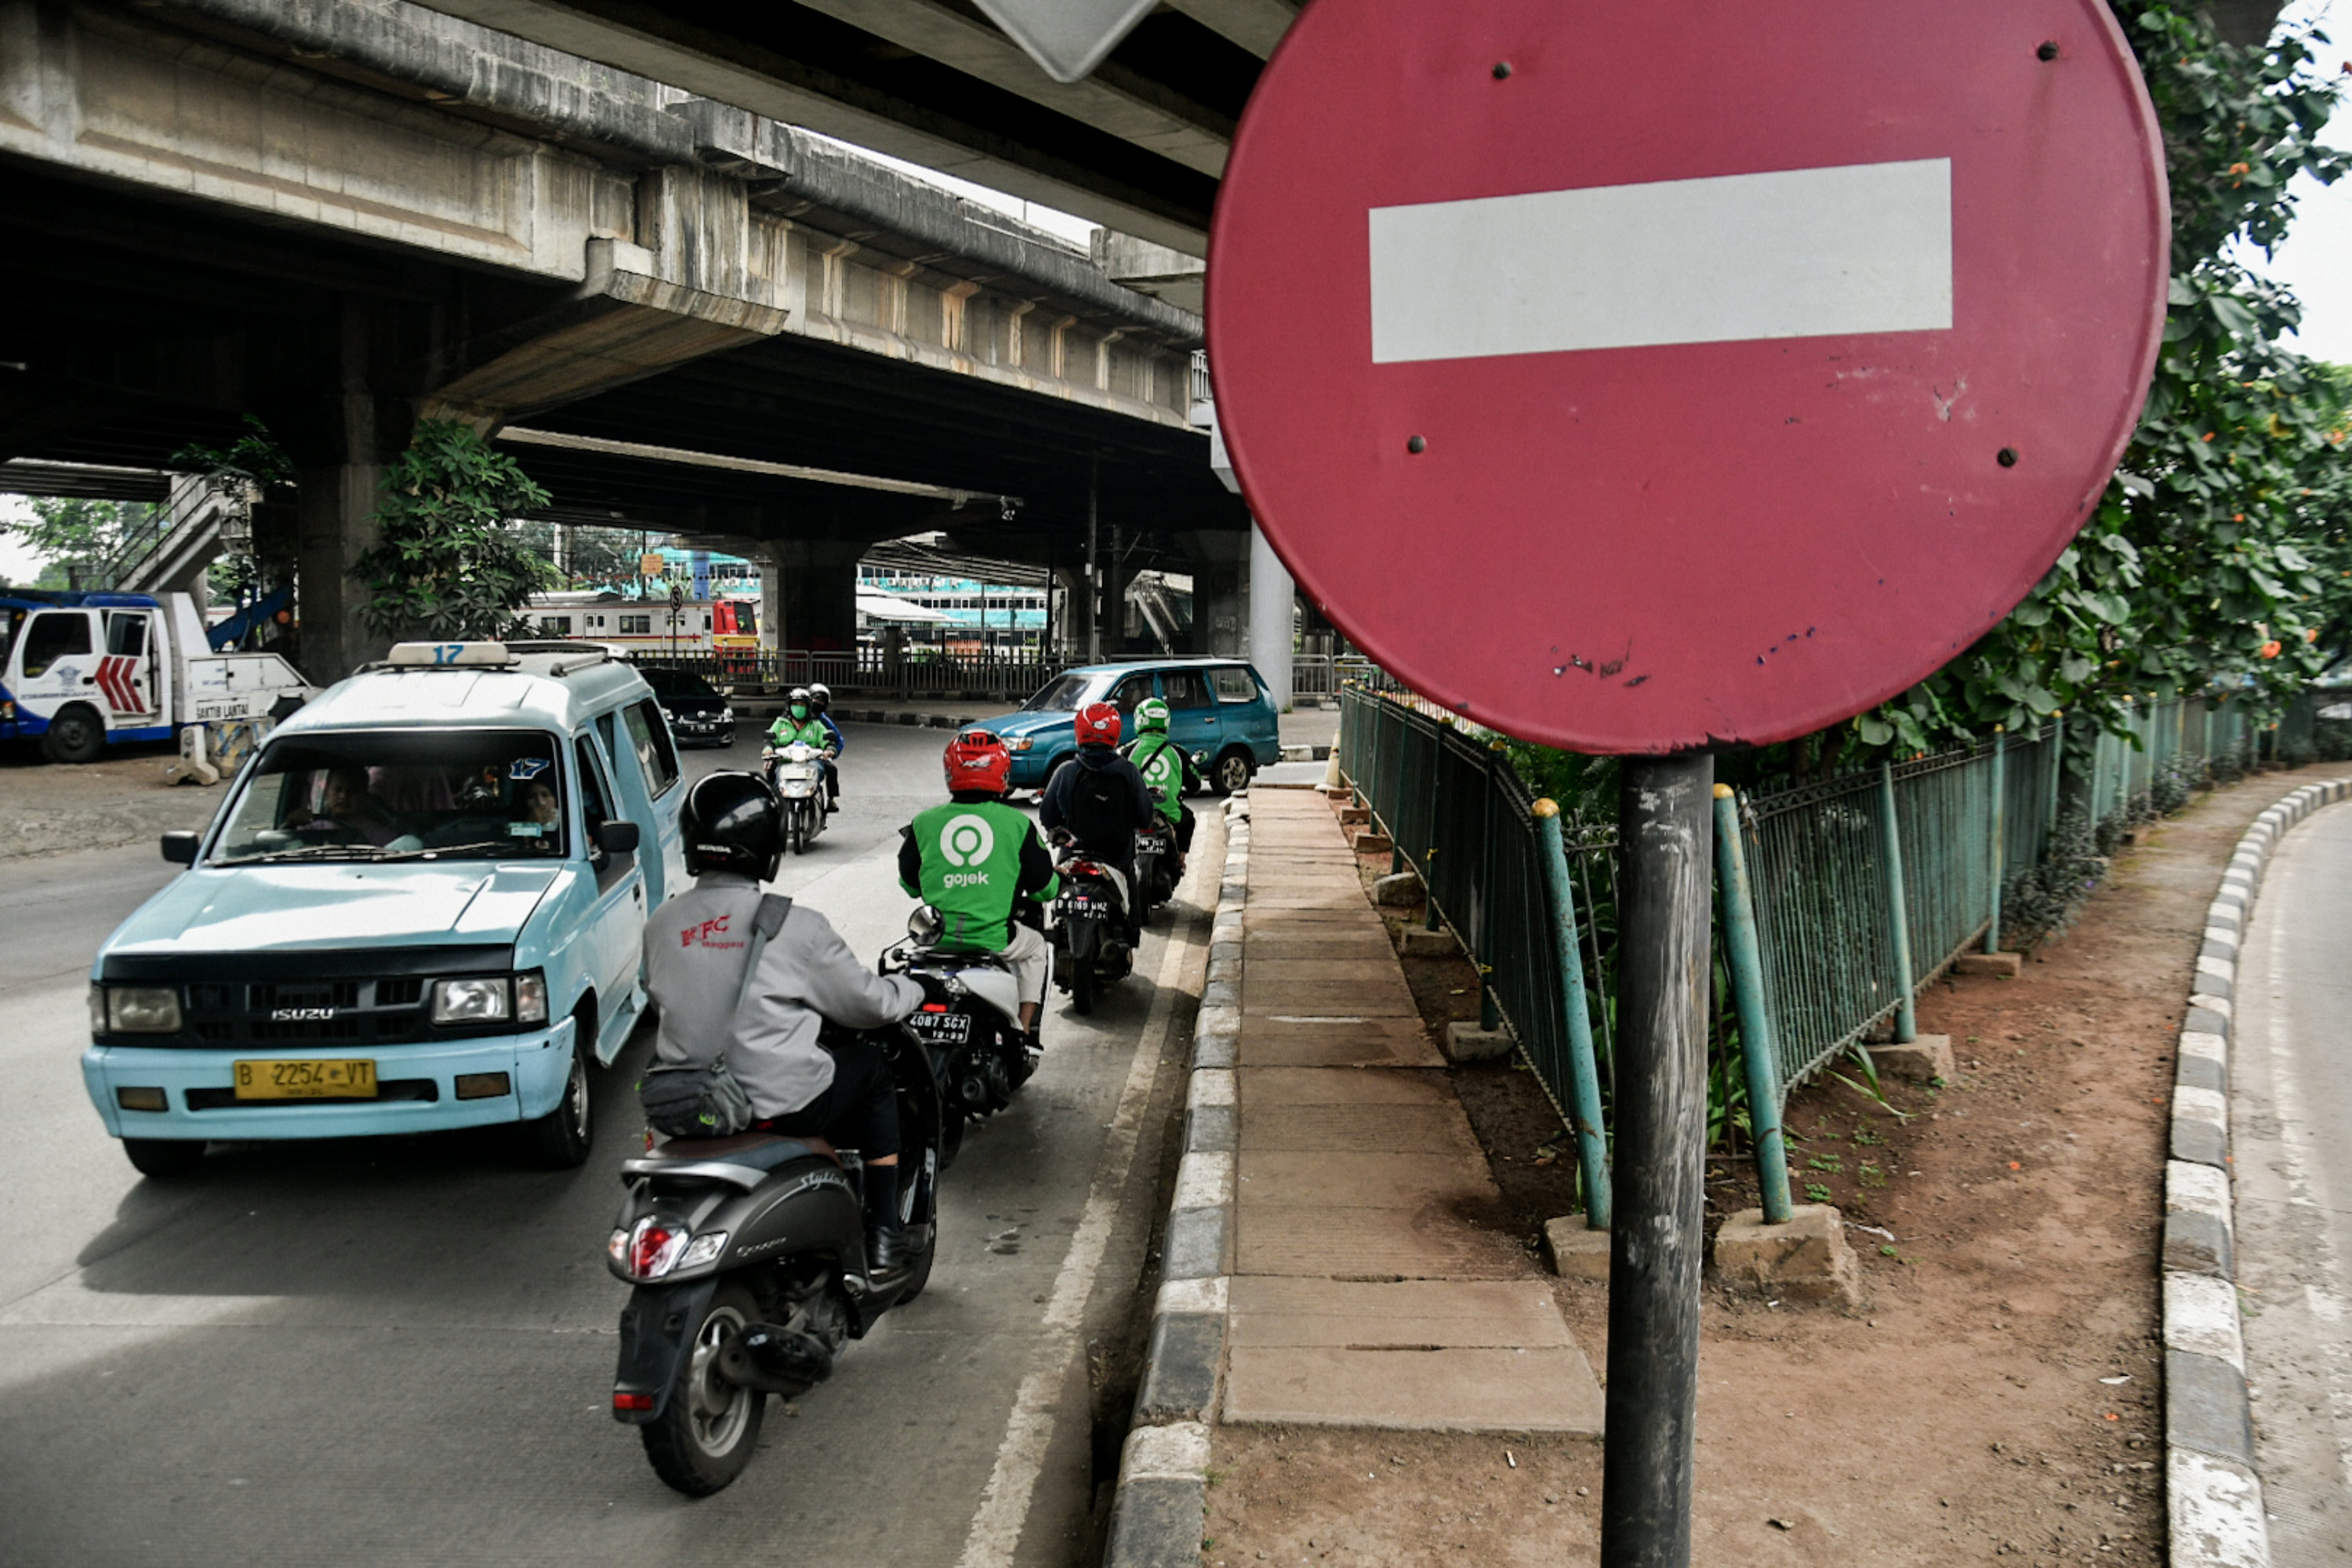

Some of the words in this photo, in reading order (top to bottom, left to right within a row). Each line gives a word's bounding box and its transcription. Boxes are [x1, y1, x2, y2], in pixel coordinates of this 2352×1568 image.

[433, 644, 464, 665] 17
[509, 757, 550, 779] 17
[943, 870, 989, 888] gojek
[272, 1008, 334, 1020] ISUZU
[240, 1064, 252, 1086] B
[274, 1062, 324, 1086] 2254
[346, 1062, 368, 1085] VT
